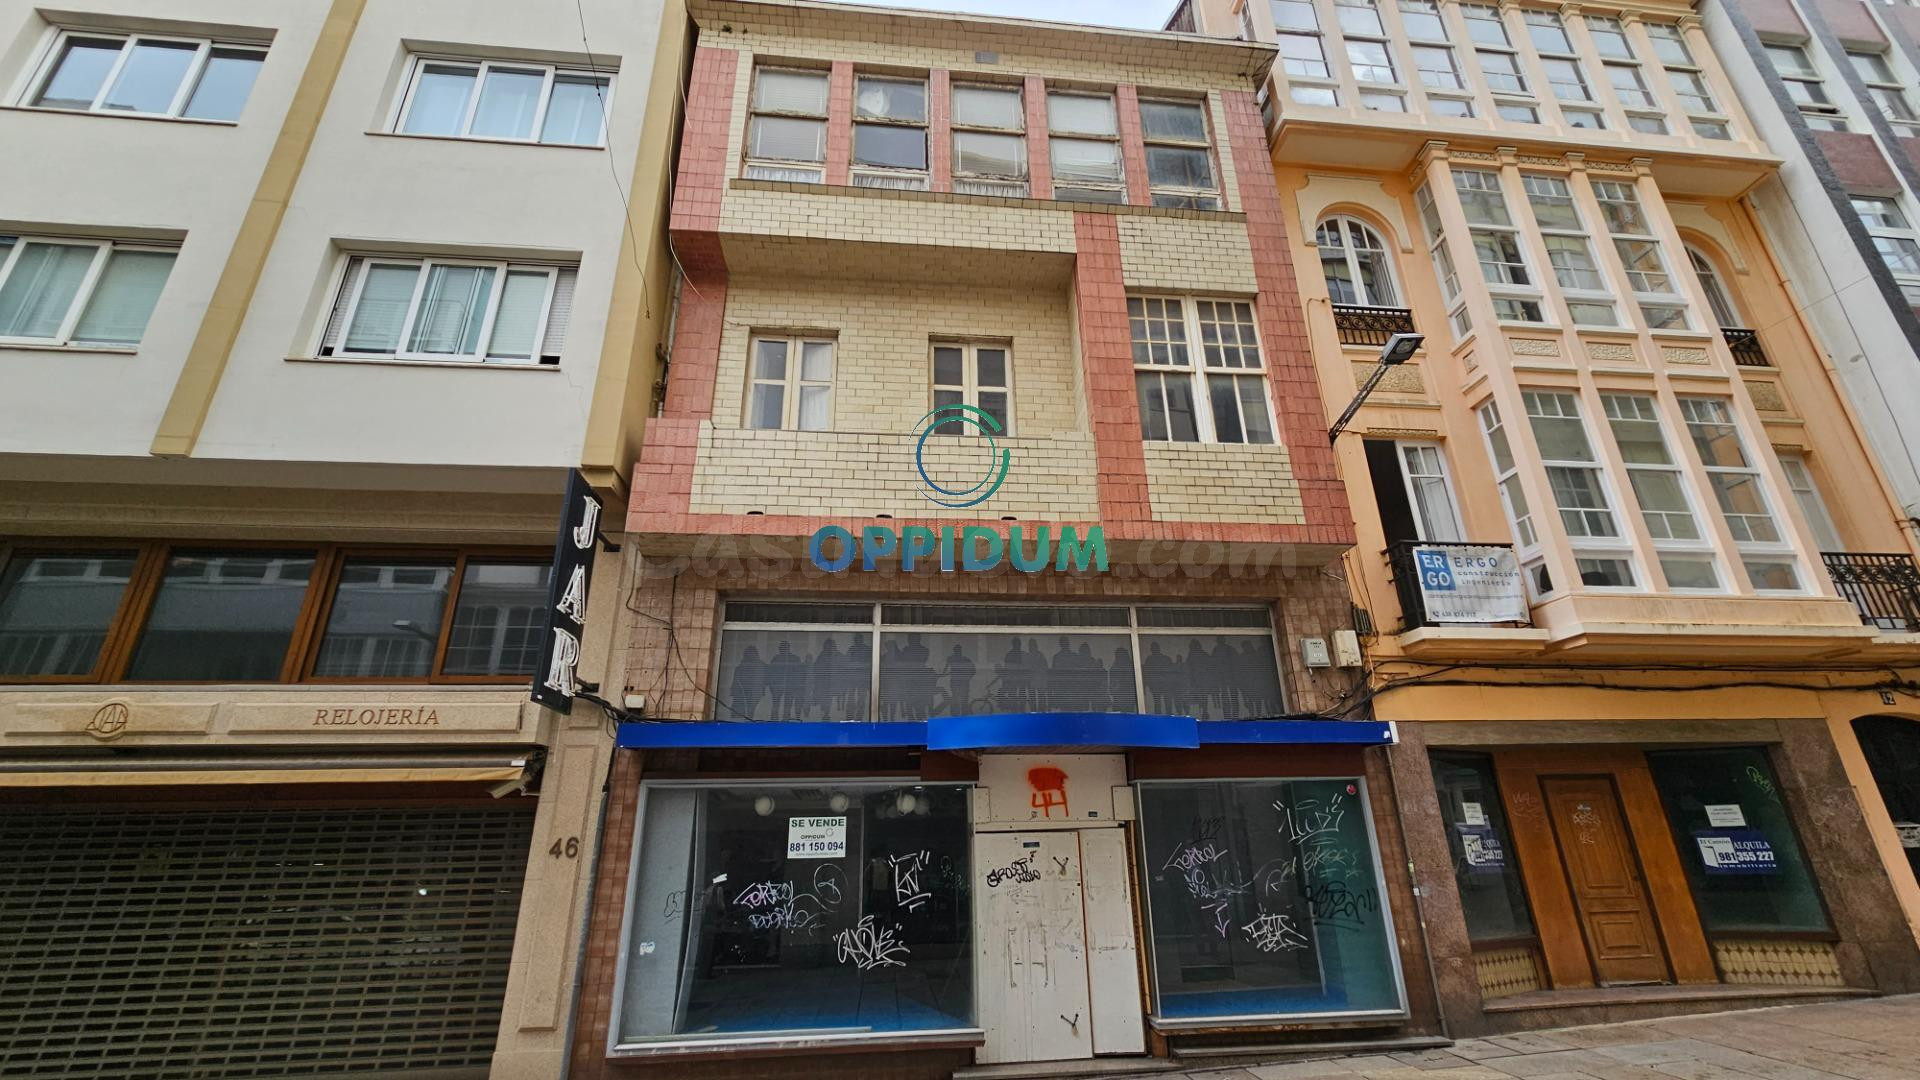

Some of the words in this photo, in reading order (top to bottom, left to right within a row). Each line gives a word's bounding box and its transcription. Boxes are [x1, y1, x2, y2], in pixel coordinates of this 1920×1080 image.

[1421, 554, 1446, 569] ER
[1453, 556, 1498, 568] ERGO
[1426, 571, 1451, 587] GO
[544, 496, 602, 697] JAR
[312, 706, 440, 726] RELOJERÍA
[791, 819, 805, 828] SE
[808, 818, 845, 828] VENDE
[549, 837, 580, 860] 46
[790, 843, 805, 852] 881
[809, 842, 825, 851] 150
[827, 841, 844, 851] 094
[1733, 841, 1771, 850] ALQUILA
[1718, 852, 1737, 861] 981
[1736, 851, 1757, 862] 355
[1757, 851, 1775, 861] 227
